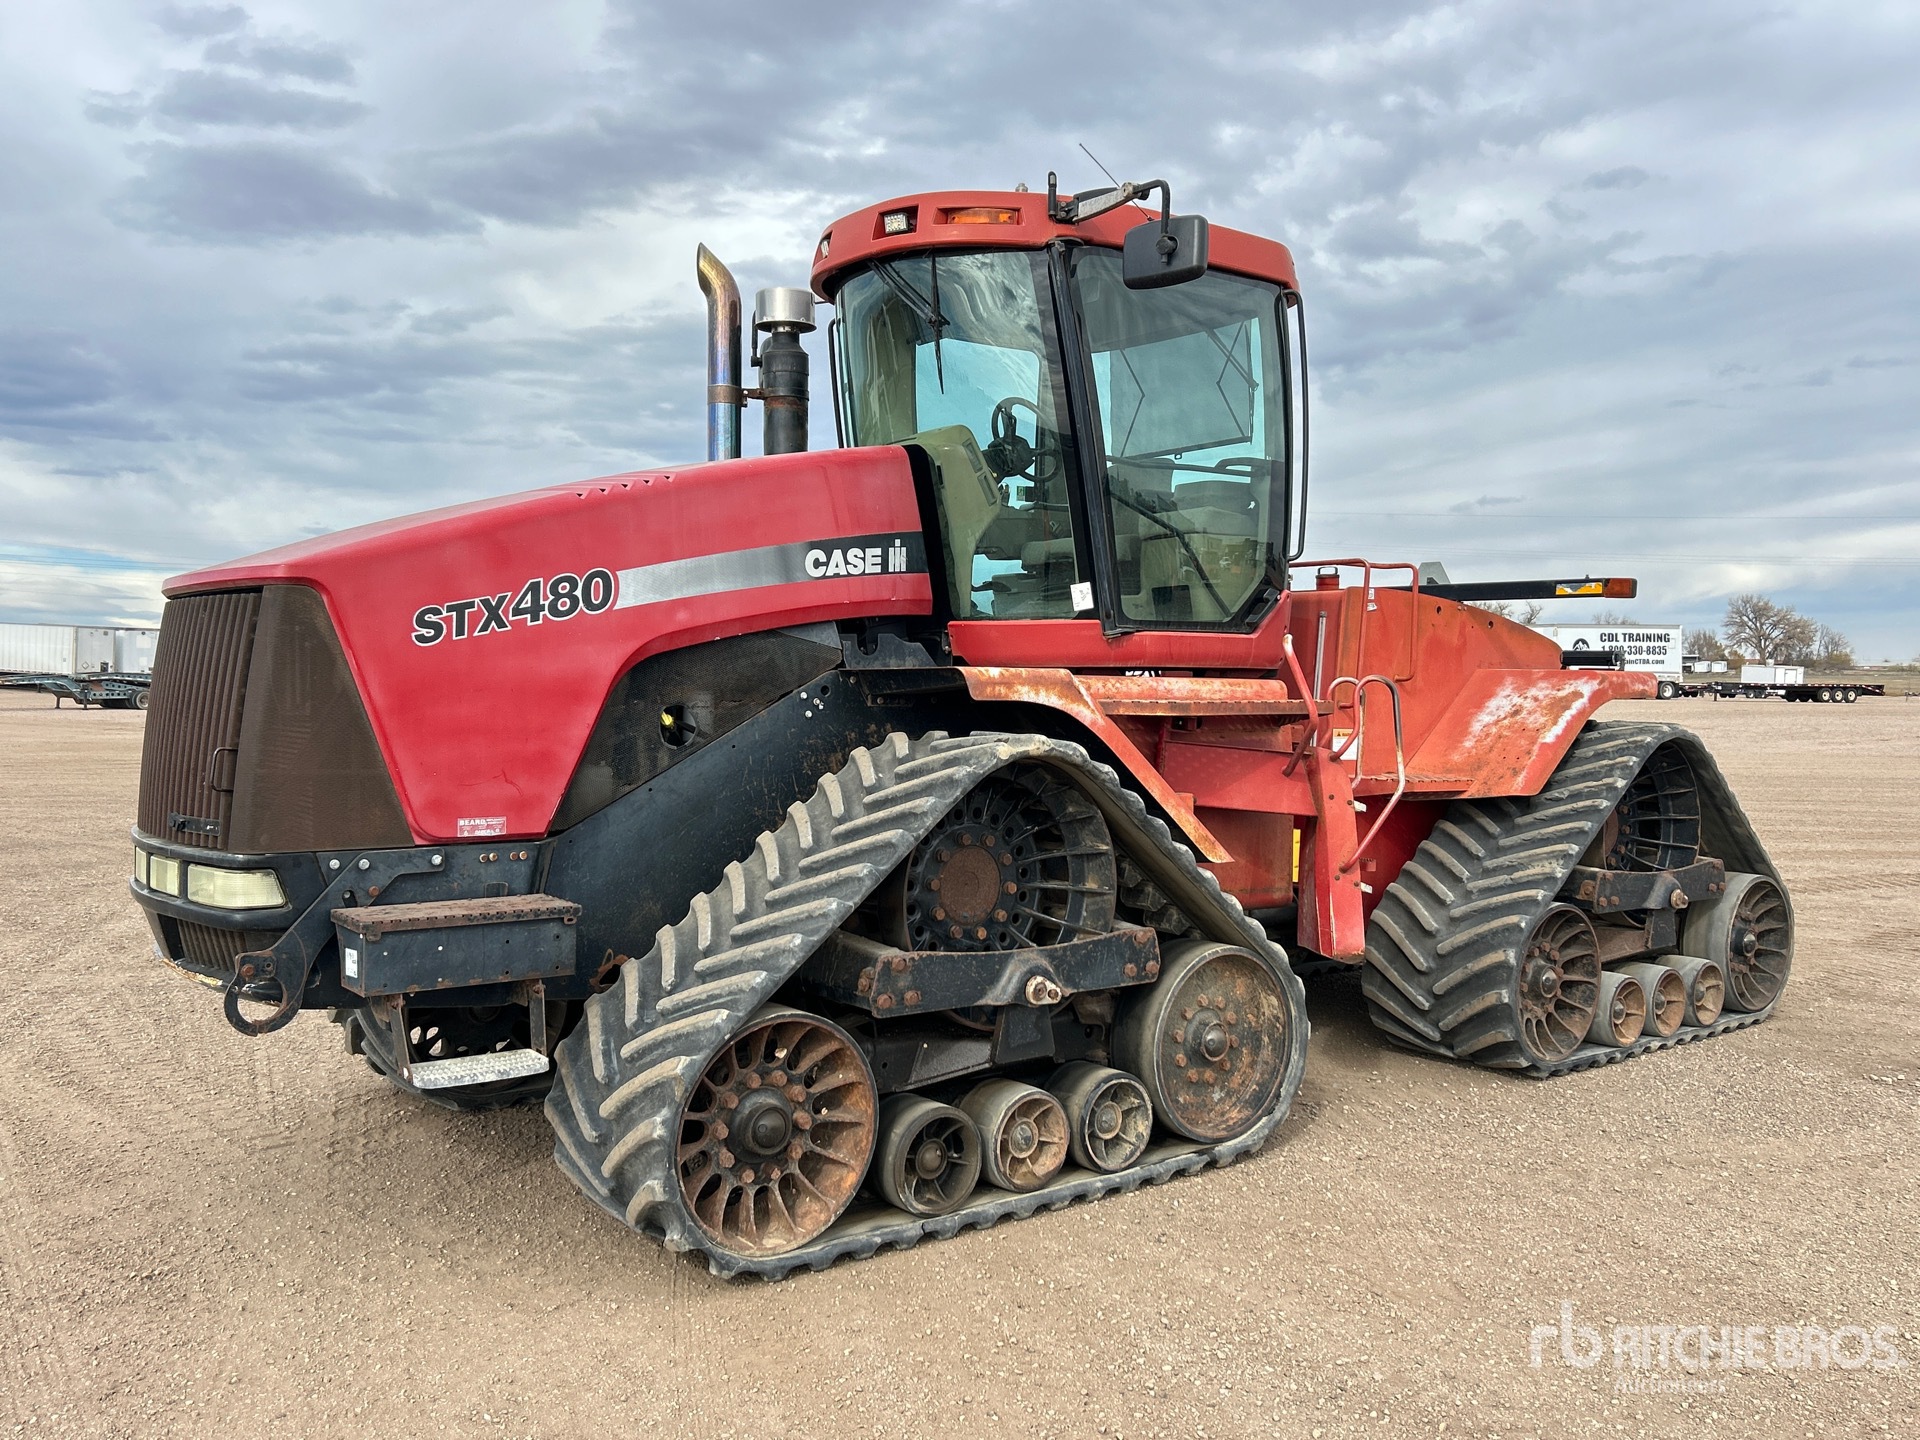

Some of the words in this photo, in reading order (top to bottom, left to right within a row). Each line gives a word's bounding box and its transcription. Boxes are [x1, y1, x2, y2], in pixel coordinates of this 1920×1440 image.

[804, 547, 882, 578] CASE
[411, 567, 614, 647] STX480
[1599, 632, 1620, 643] CDL
[1621, 632, 1671, 643] TRAINING
[1601, 645, 1668, 656] 1800-330-8835
